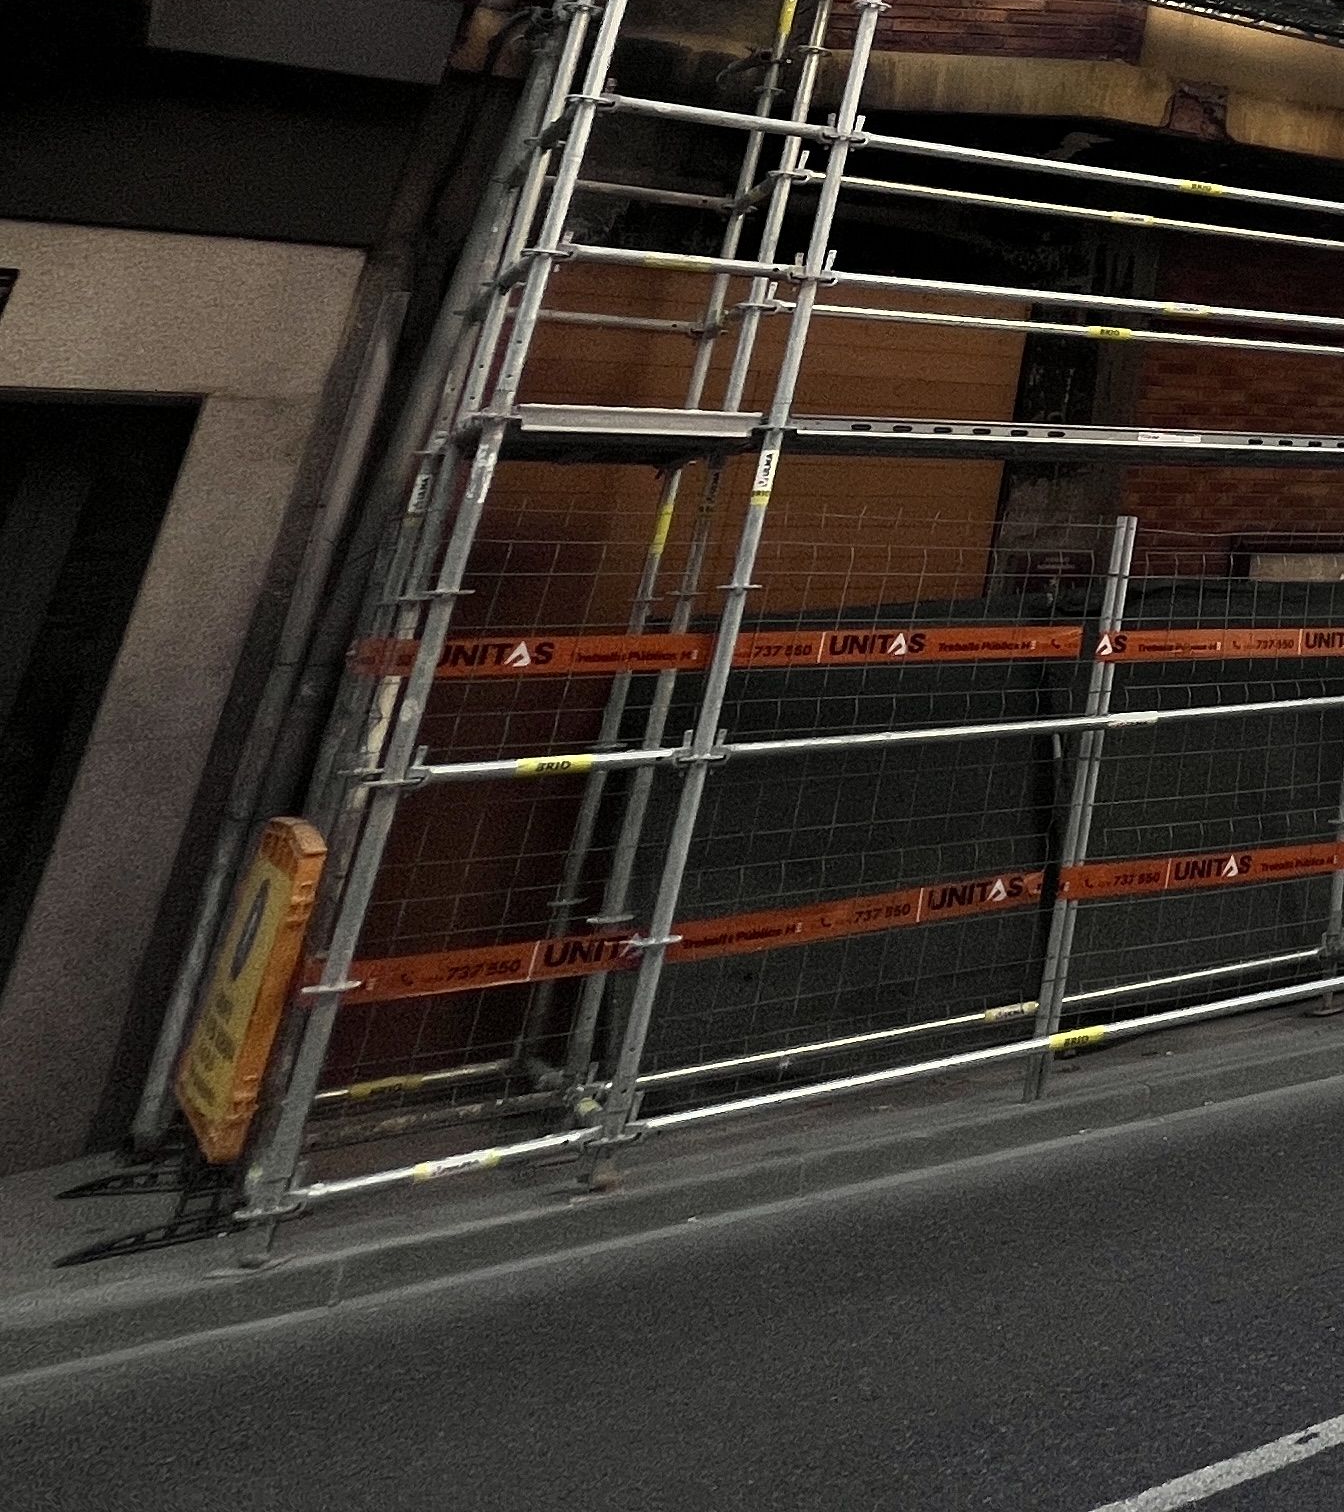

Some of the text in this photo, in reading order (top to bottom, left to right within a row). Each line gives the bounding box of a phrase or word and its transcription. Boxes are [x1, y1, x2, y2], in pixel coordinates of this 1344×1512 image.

[829, 632, 927, 656] UNITAS
[535, 760, 572, 773] BRIO
[1174, 854, 1253, 882] UNITAS
[927, 876, 1024, 911] UNITAS
